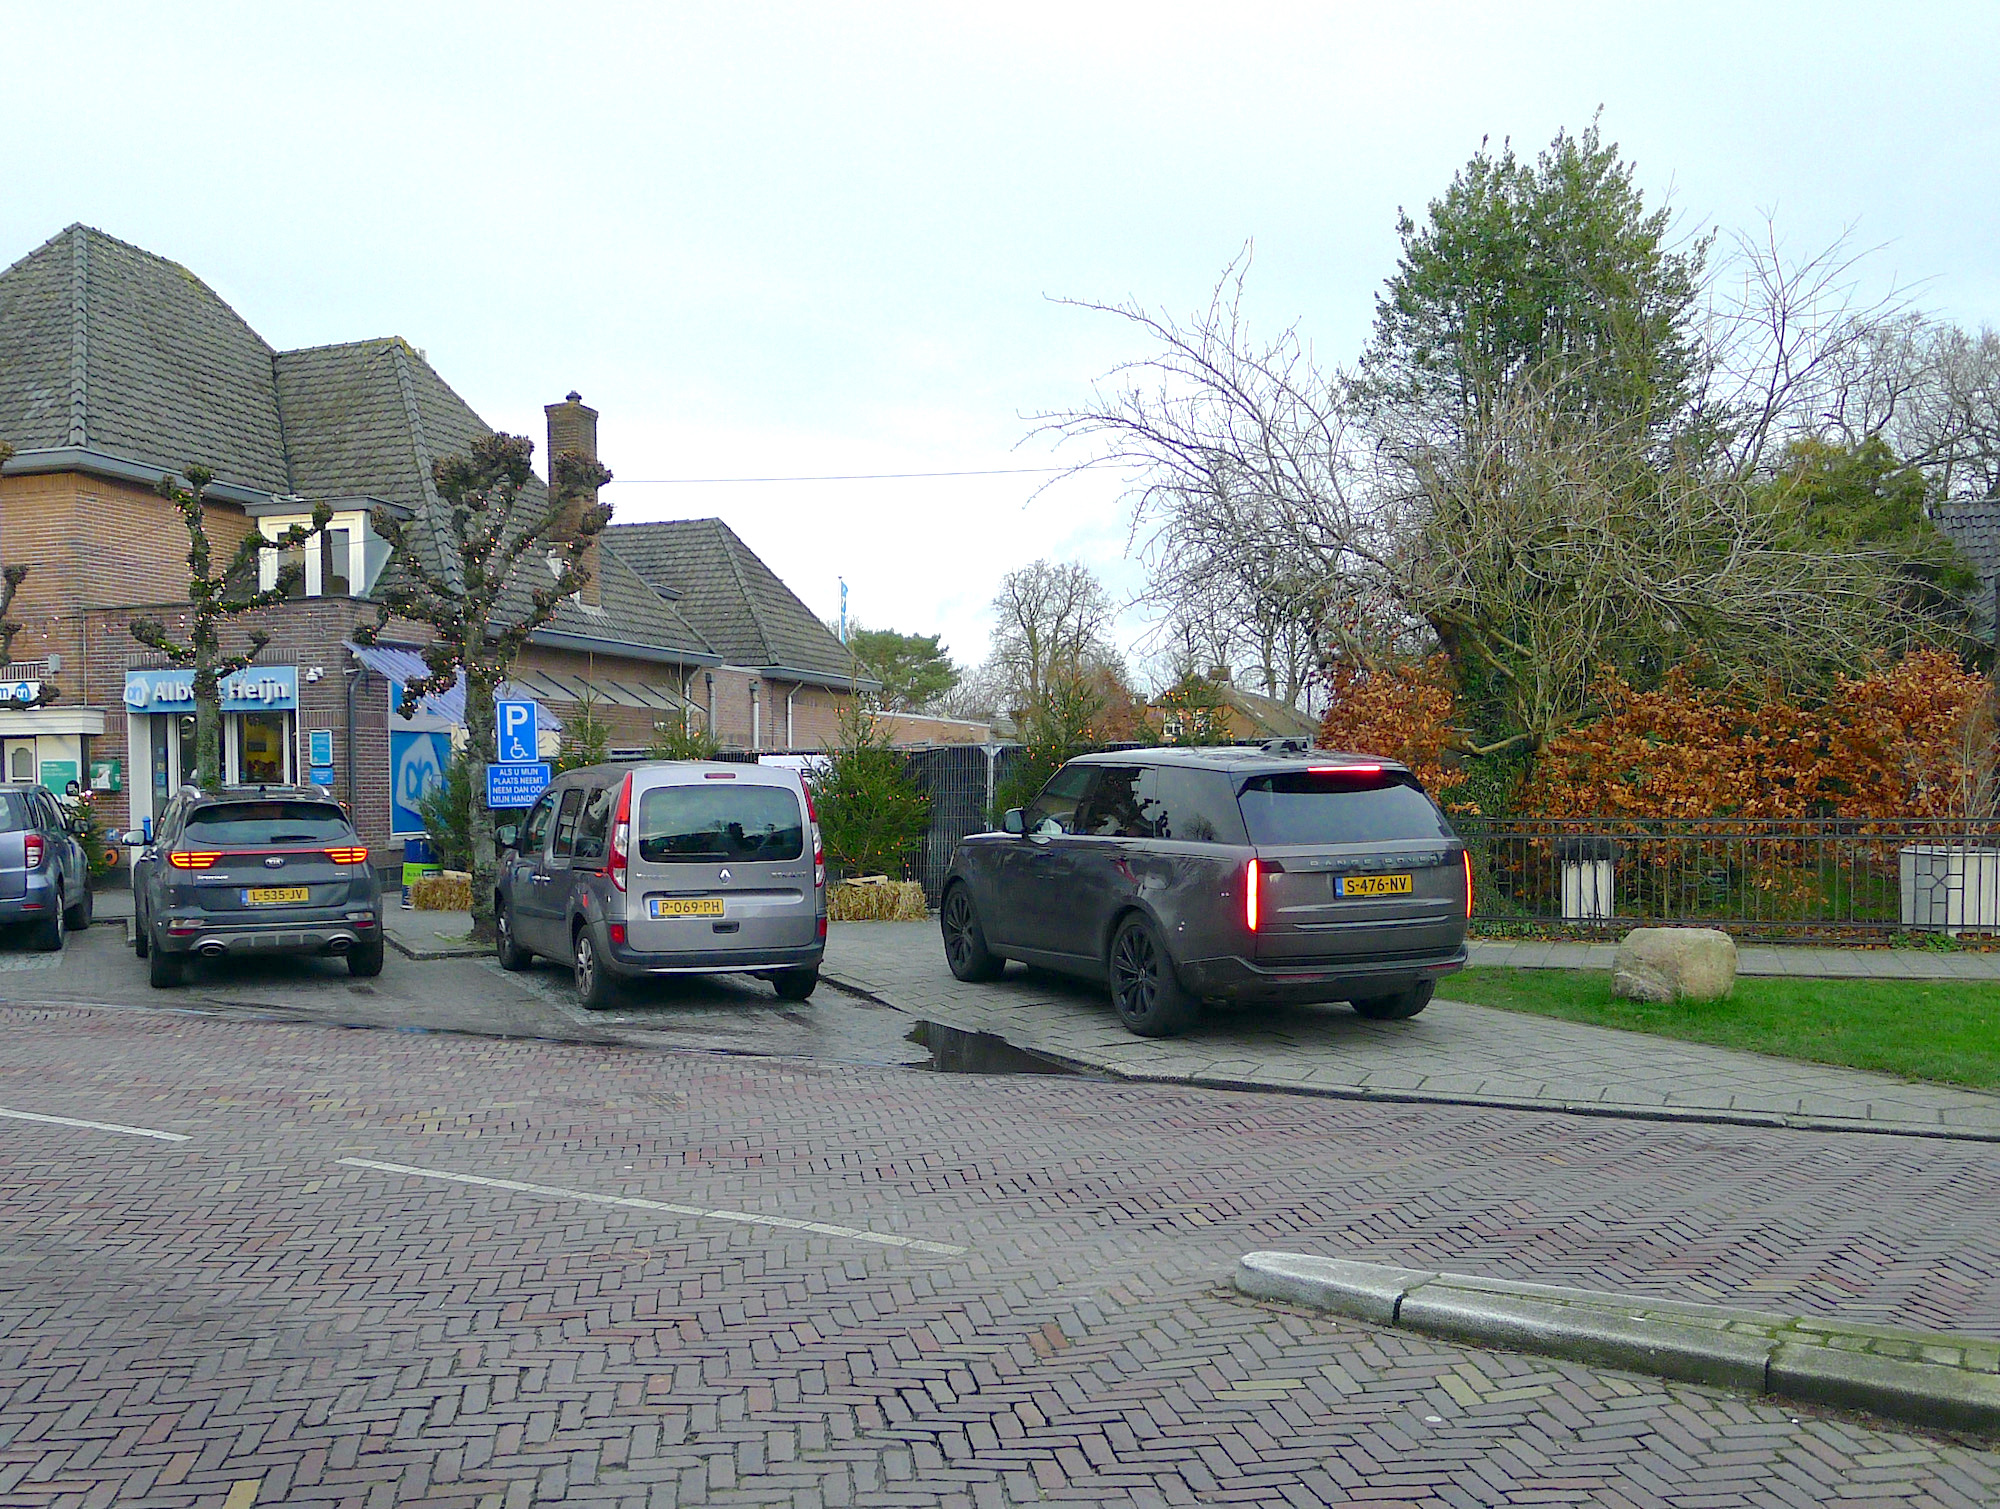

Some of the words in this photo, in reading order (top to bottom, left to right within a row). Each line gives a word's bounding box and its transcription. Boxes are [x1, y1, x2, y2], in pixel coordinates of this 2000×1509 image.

[153, 681, 221, 702] Alb
[228, 676, 291, 704] Heijn
[505, 705, 529, 737] P
[499, 767, 513, 776] ALS
[514, 767, 520, 776] U
[520, 767, 539, 776] MIJN
[493, 777, 519, 785] PLAATS
[492, 786, 513, 794] NEEM
[513, 785, 529, 794] DAN
[492, 795, 510, 803] MIJN
[511, 794, 539, 803] HANDIC
[1347, 877, 1407, 893] S-476-NV
[252, 889, 304, 901] L-535-JV
[661, 901, 721, 914] P-069-PH
